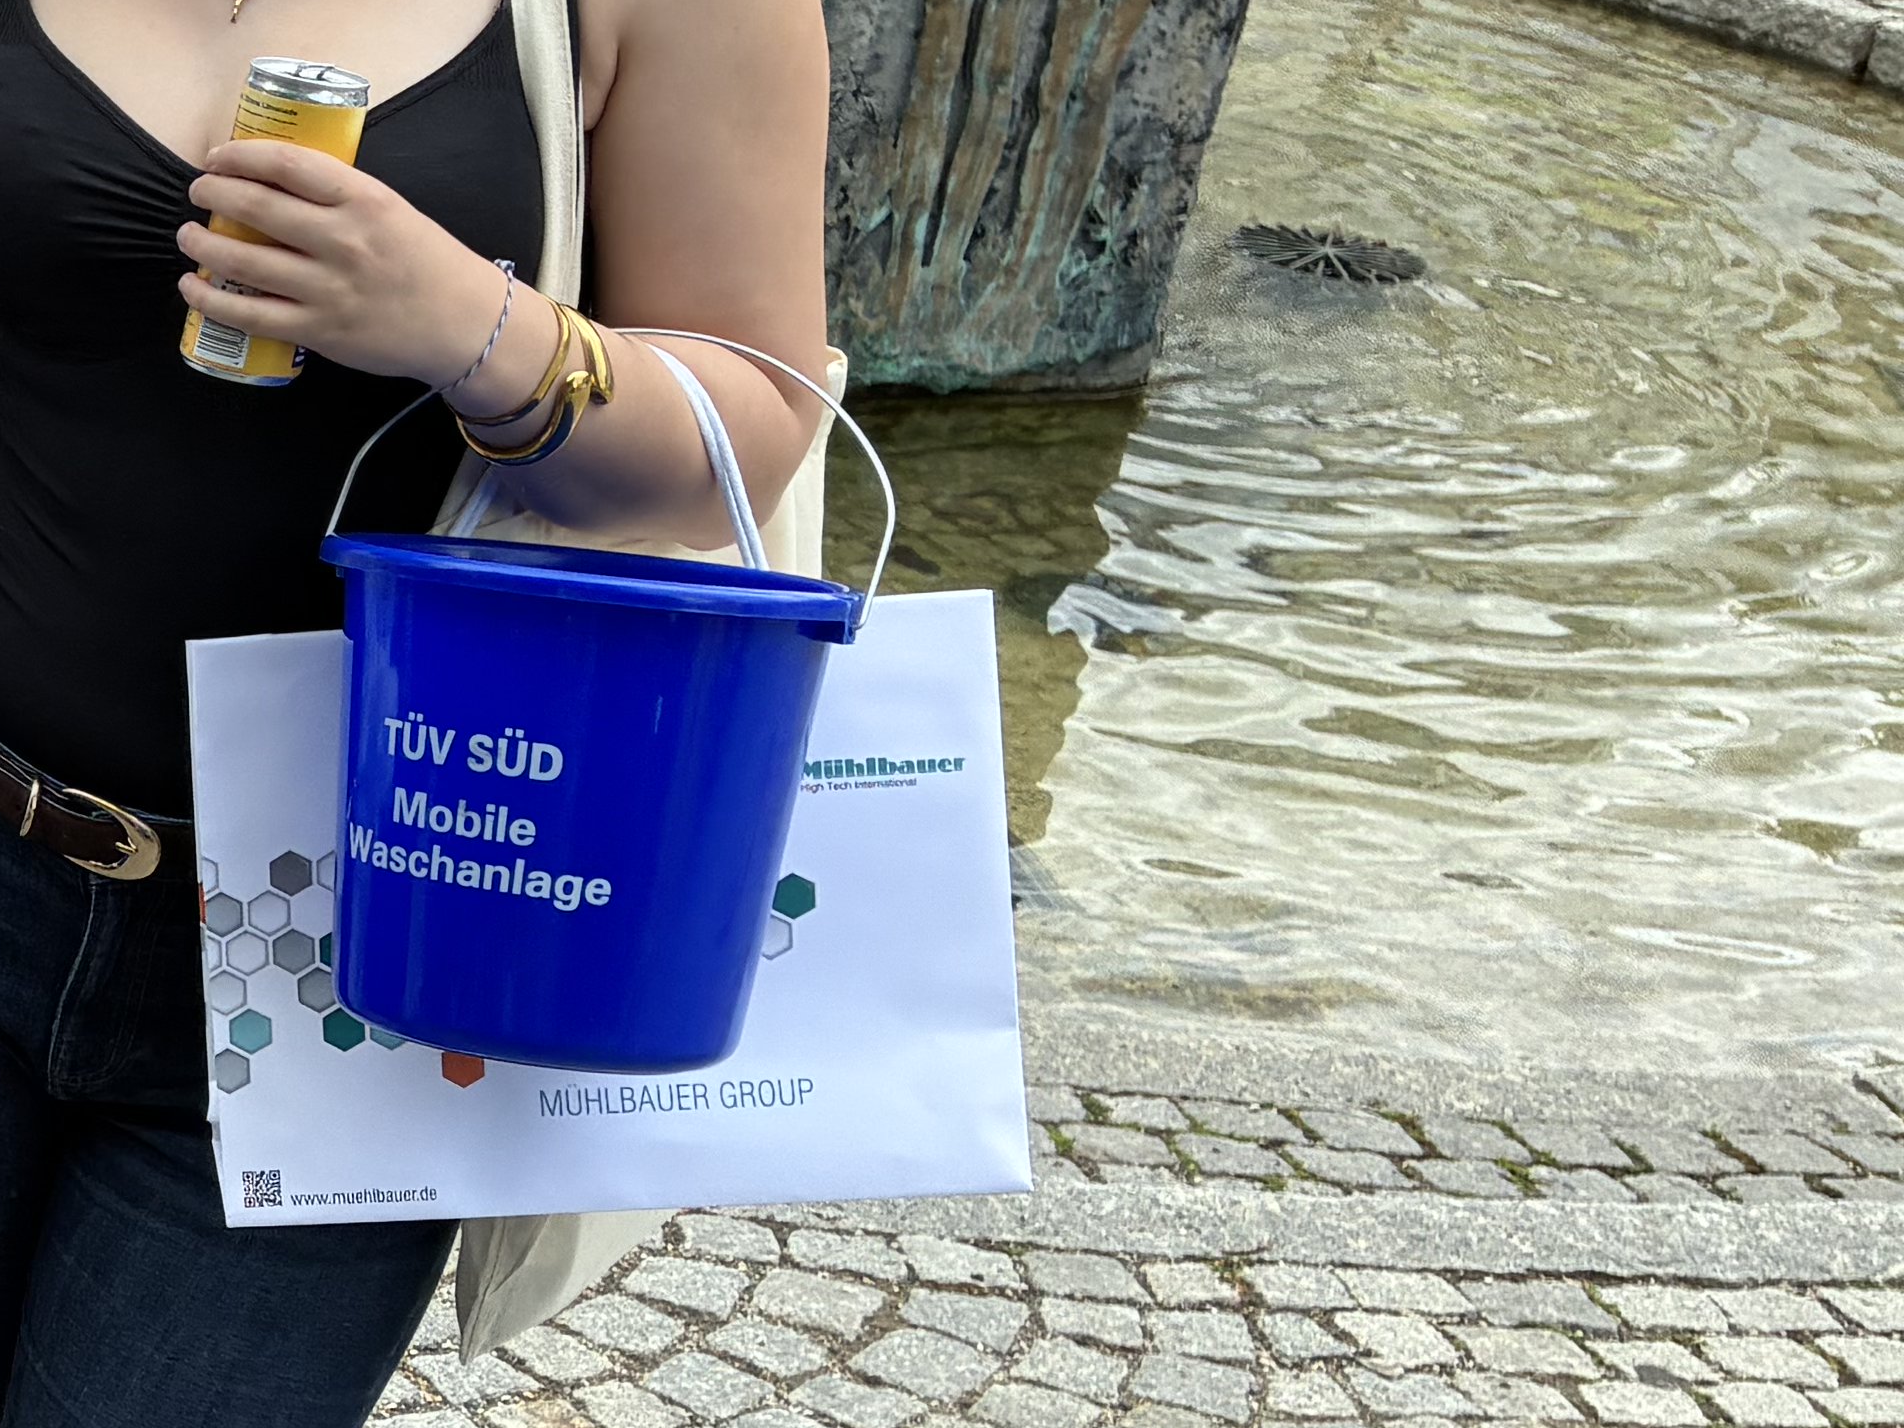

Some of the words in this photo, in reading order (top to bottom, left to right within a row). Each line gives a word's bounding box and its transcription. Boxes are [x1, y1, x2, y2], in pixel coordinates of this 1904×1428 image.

[384, 711, 456, 765] TÜV
[467, 727, 563, 781] SÜD
[802, 757, 966, 780] Mühlbauer
[828, 780, 852, 791] Tech
[393, 786, 536, 846] Mobile
[349, 822, 612, 911] Waschanlage
[539, 1082, 710, 1117] MÜHLBAUER
[719, 1078, 814, 1110] GROUP
[290, 1185, 438, 1206] www.muehlbauer.de
